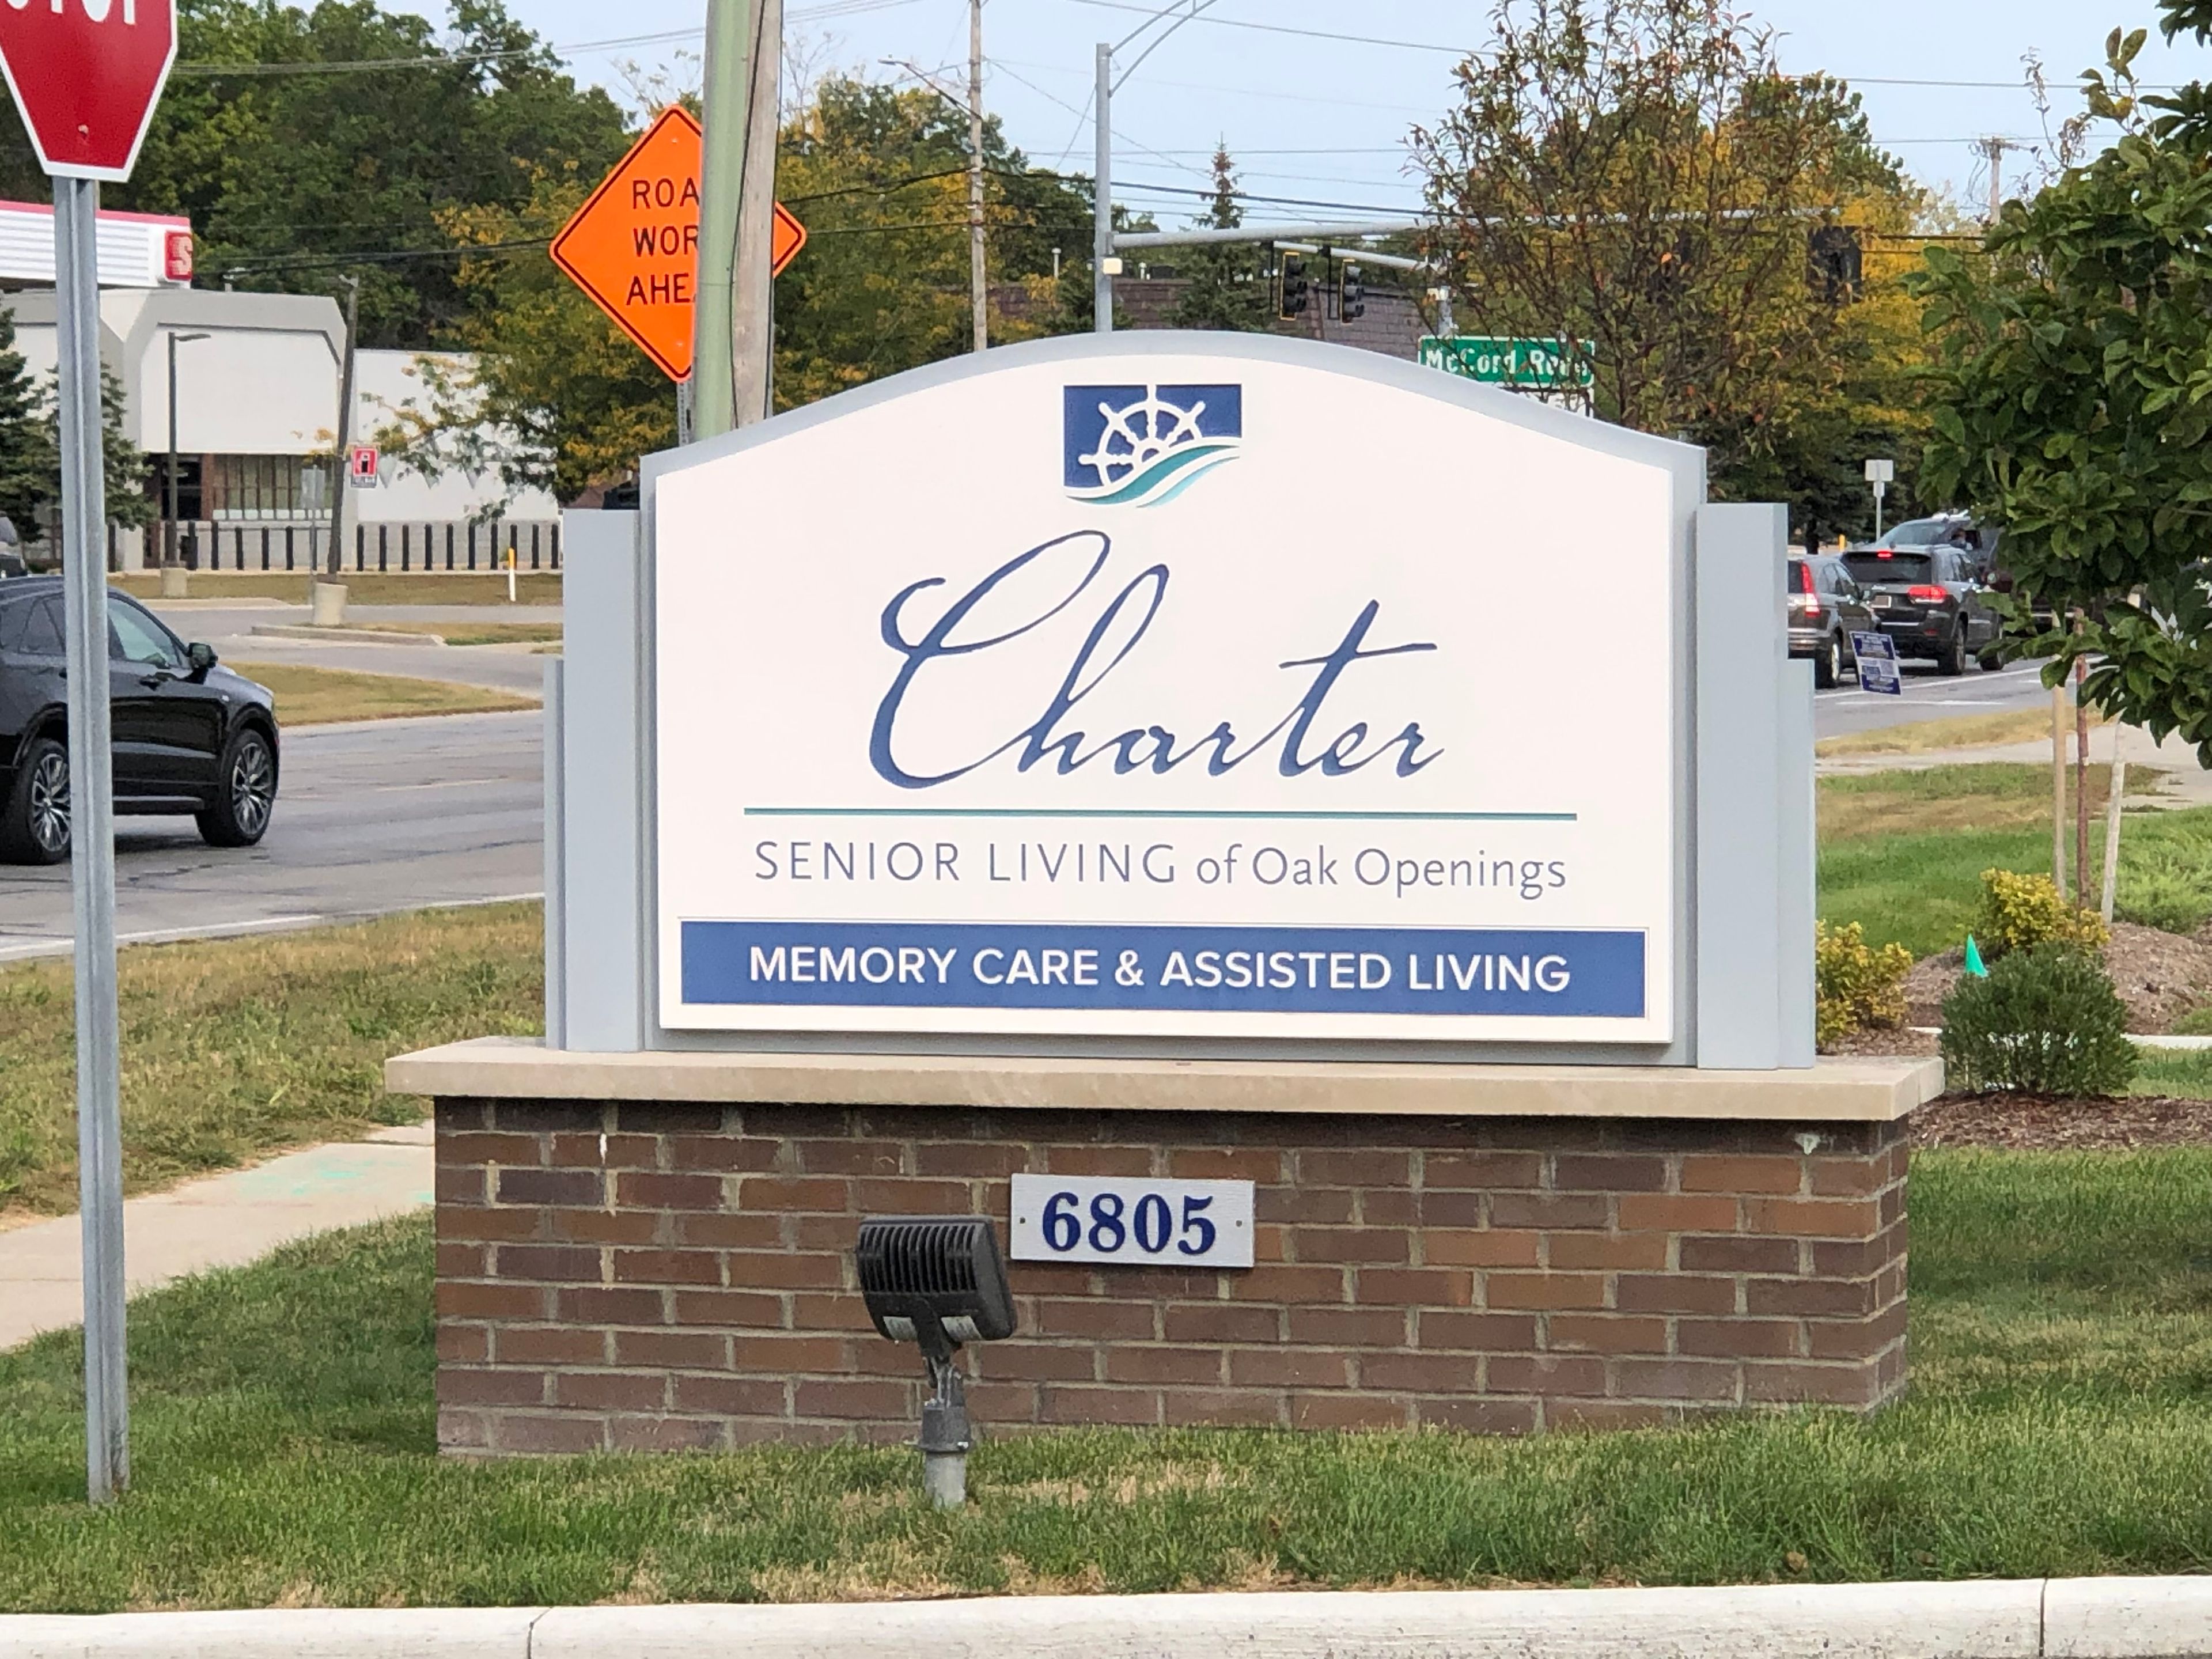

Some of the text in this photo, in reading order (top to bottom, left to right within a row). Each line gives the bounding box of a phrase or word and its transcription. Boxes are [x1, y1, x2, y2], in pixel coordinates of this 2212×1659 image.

[632, 177, 699, 209] ROA
[633, 225, 699, 257] WOR
[626, 272, 696, 306] AHE
[1426, 347, 1517, 374] McCord
[869, 529, 1444, 789] Charter
[755, 841, 1566, 900] SENIOR LIVING of Oak Openings
[751, 946, 1570, 993] MEMORY CARE & ASSISTED LIVING
[1042, 1192, 1216, 1256] 6805
